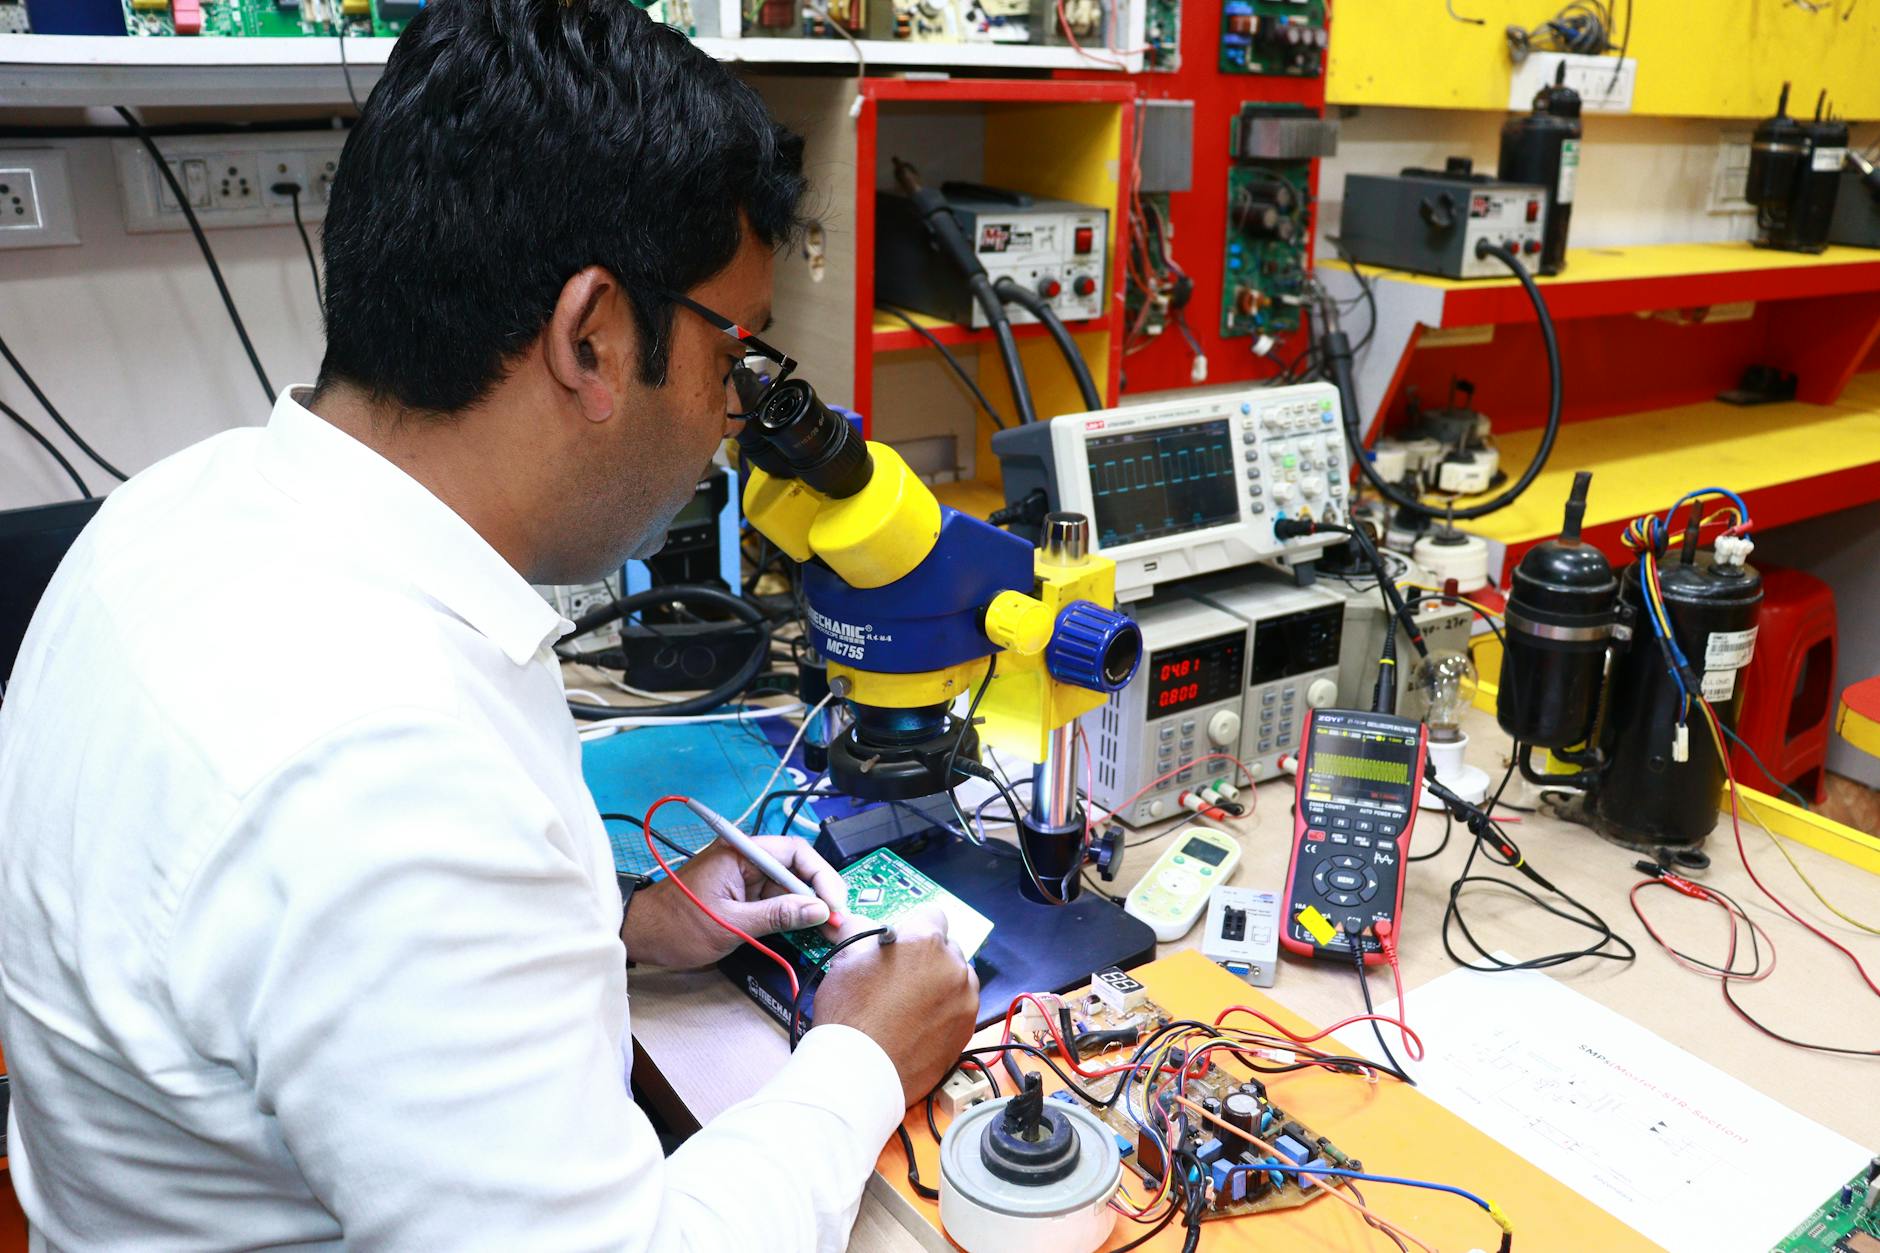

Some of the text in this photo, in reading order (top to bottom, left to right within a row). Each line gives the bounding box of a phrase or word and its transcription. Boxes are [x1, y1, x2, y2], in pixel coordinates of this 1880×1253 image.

[808, 606, 865, 639] MECHANIC
[826, 638, 864, 660] MC75S
[1318, 715, 1341, 723] ZOYI
